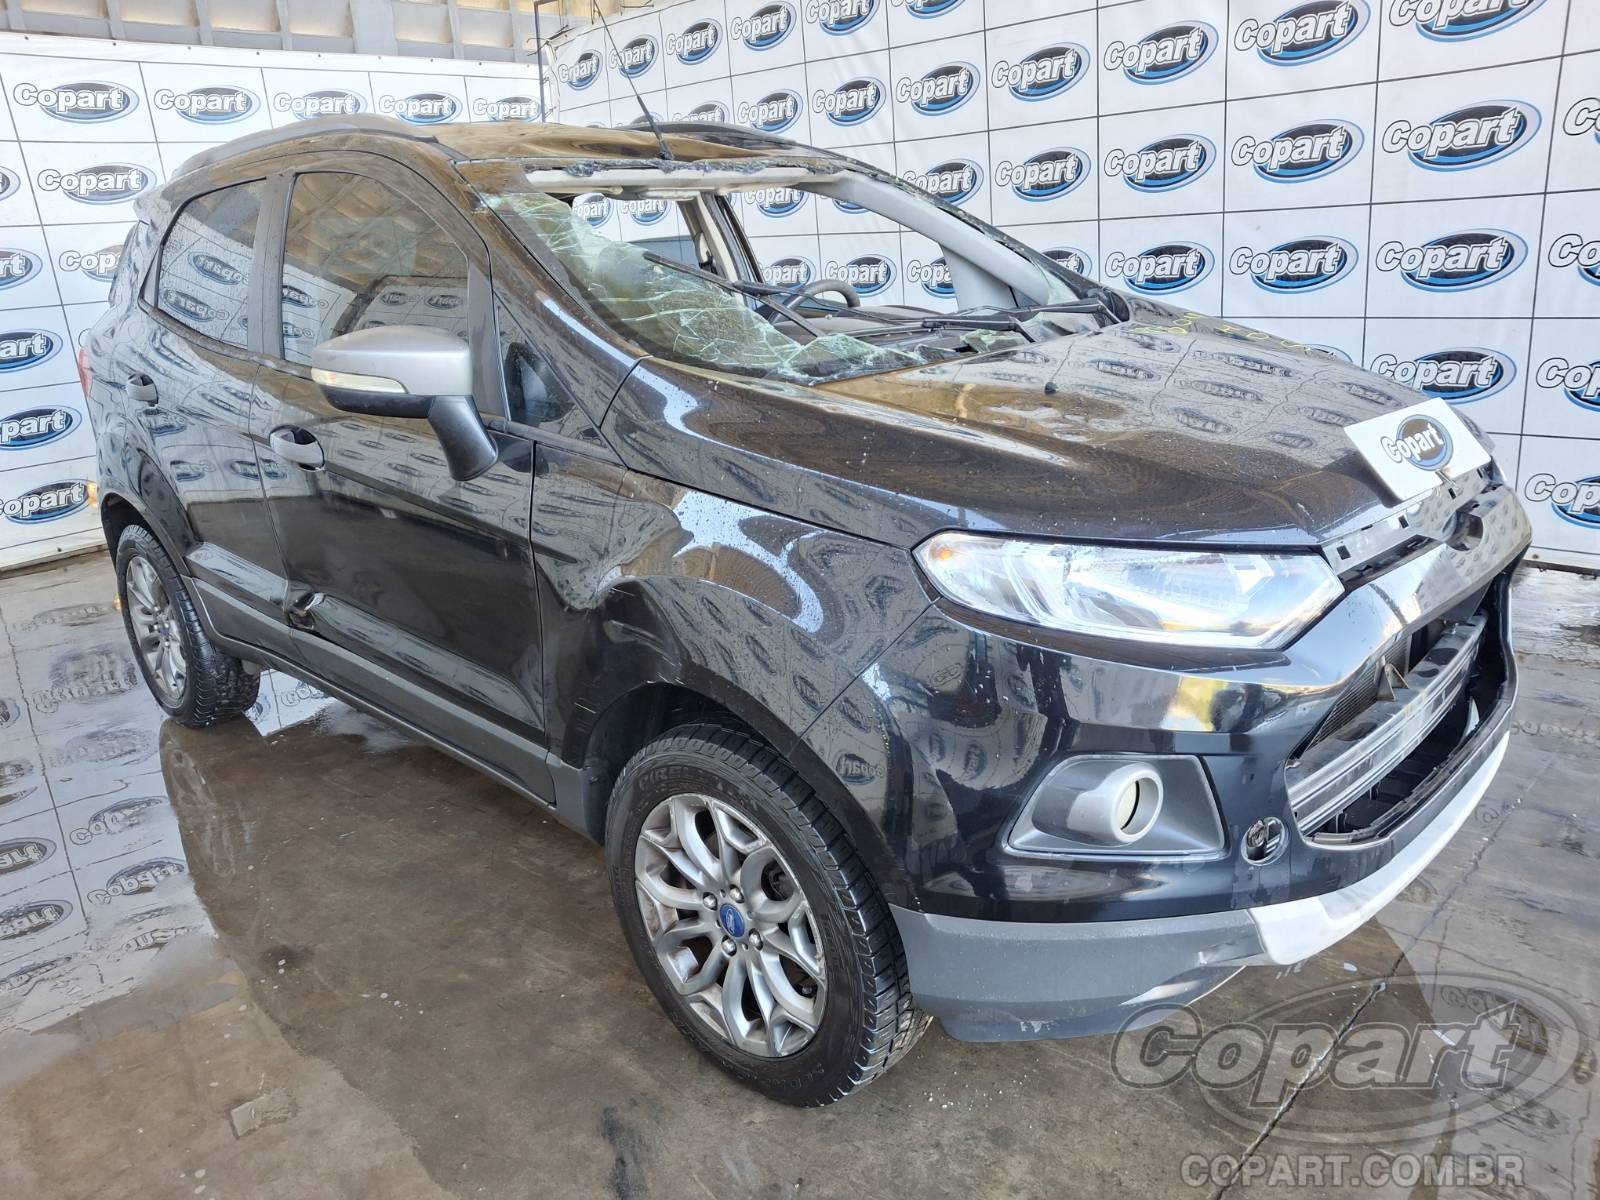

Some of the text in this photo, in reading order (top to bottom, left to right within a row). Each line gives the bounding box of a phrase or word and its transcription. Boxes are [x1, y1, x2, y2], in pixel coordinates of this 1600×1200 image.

[666, 23, 716, 58] Copart
[730, 5, 788, 43] Copart
[1234, 0, 1353, 55] Copart
[991, 48, 1079, 92] Copart
[1104, 27, 1204, 74] Copart
[13, 82, 124, 112] Copart
[154, 88, 247, 115] Copart
[274, 93, 355, 116] Copart
[379, 94, 451, 117] Copart
[812, 81, 876, 118] Copart
[896, 66, 970, 107] Copart
[473, 97, 540, 118] Copart
[737, 93, 795, 128] Copart
[1231, 125, 1350, 172] Copart
[1382, 106, 1521, 158] Copart
[995, 151, 1080, 191] Copart
[1104, 141, 1204, 181] Copart
[37, 168, 143, 196] Copart
[825, 260, 888, 286] Copart
[1104, 239, 1205, 286] Copart
[1229, 241, 1341, 282] Copart
[1375, 236, 1511, 278] Copart
[1371, 354, 1498, 389] Copart
[1380, 422, 1444, 463] Copart
